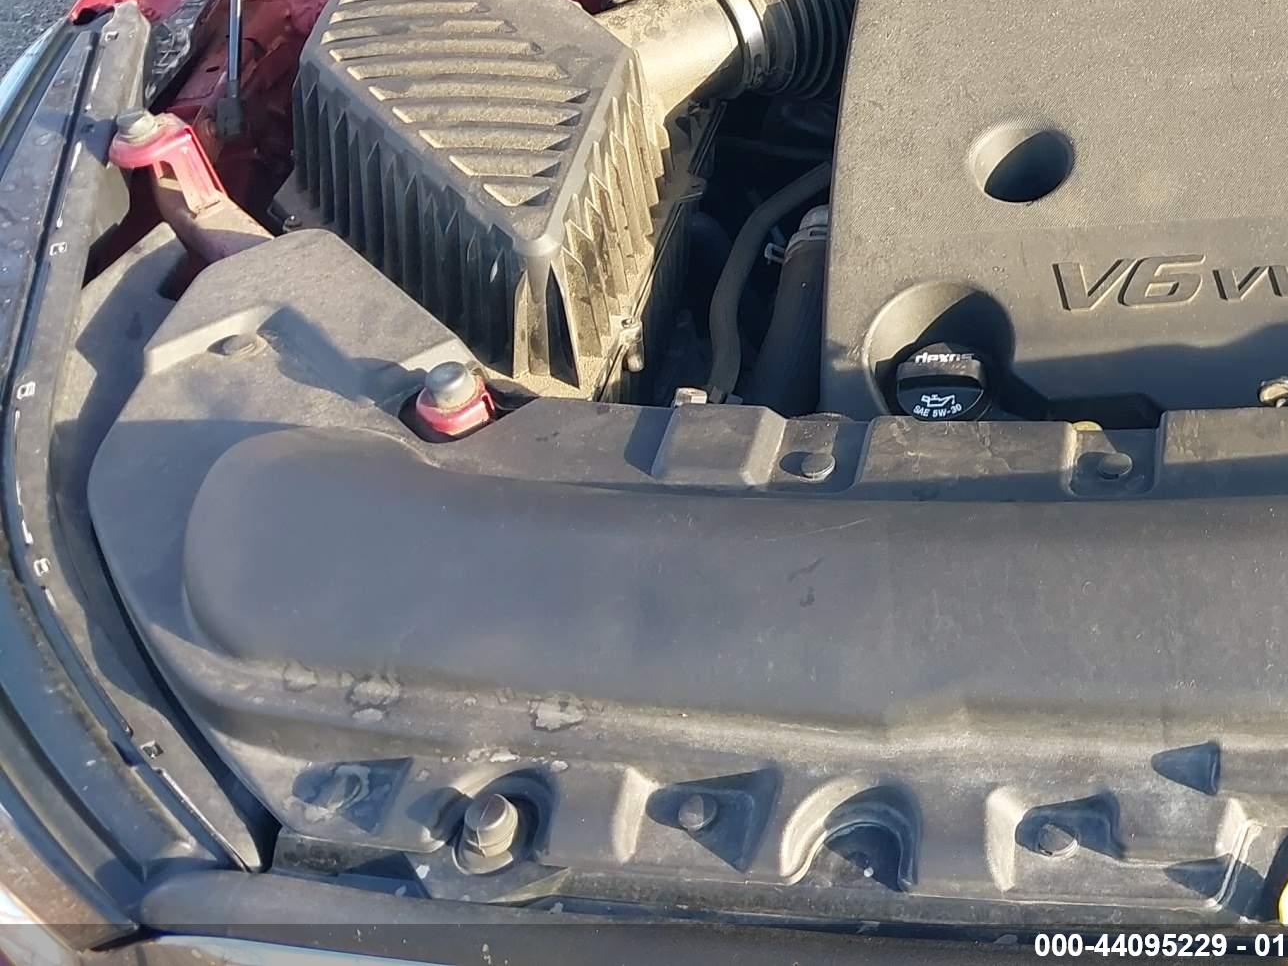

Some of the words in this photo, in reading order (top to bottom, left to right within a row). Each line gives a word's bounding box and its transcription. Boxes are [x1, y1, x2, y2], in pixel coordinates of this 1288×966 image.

[1052, 253, 1206, 312] V6
[913, 404, 930, 417] SAE
[932, 403, 962, 418] 5W-30
